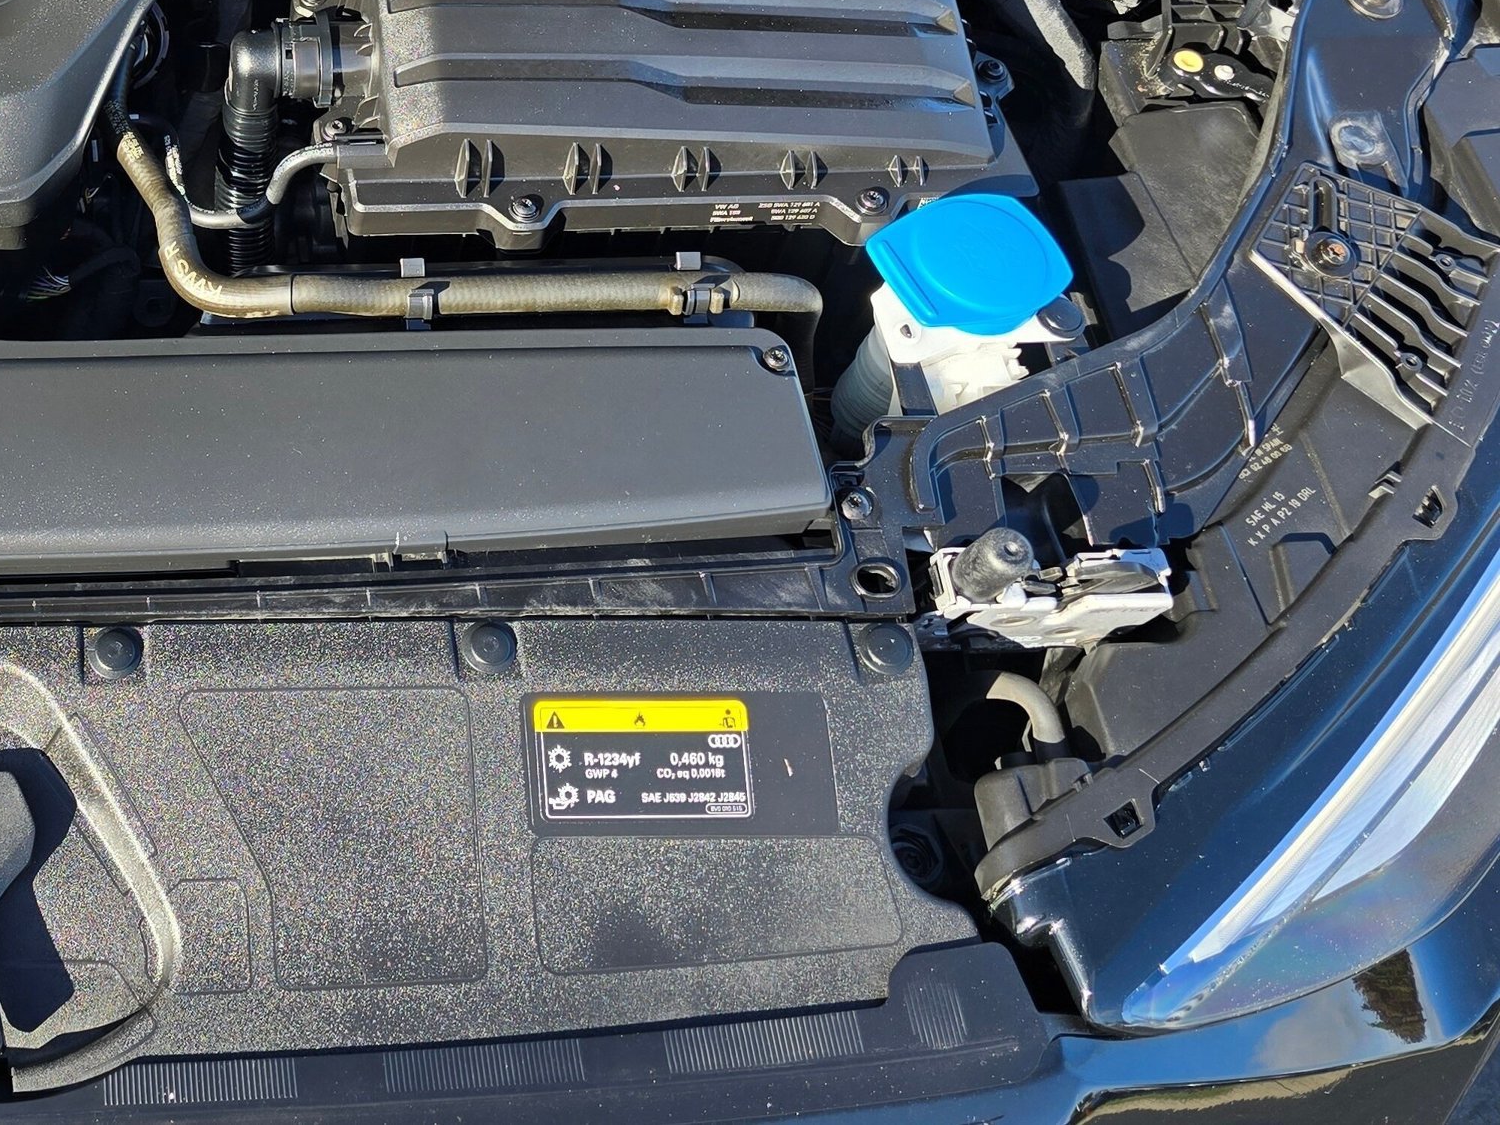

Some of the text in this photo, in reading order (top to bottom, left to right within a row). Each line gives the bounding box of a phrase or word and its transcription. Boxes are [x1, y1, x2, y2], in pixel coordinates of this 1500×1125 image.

[1246, 491, 1286, 527] SAE HL 15
[1248, 486, 1316, 547] K X P A P2 19 DRL
[584, 752, 640, 769] R-1234yf
[670, 752, 724, 767] 0,460 kg
[585, 768, 618, 779] GWP 4
[677, 770, 690, 780] eq
[587, 790, 616, 804] PAG
[641, 792, 746, 803] SAE J639 J2842 J2845
